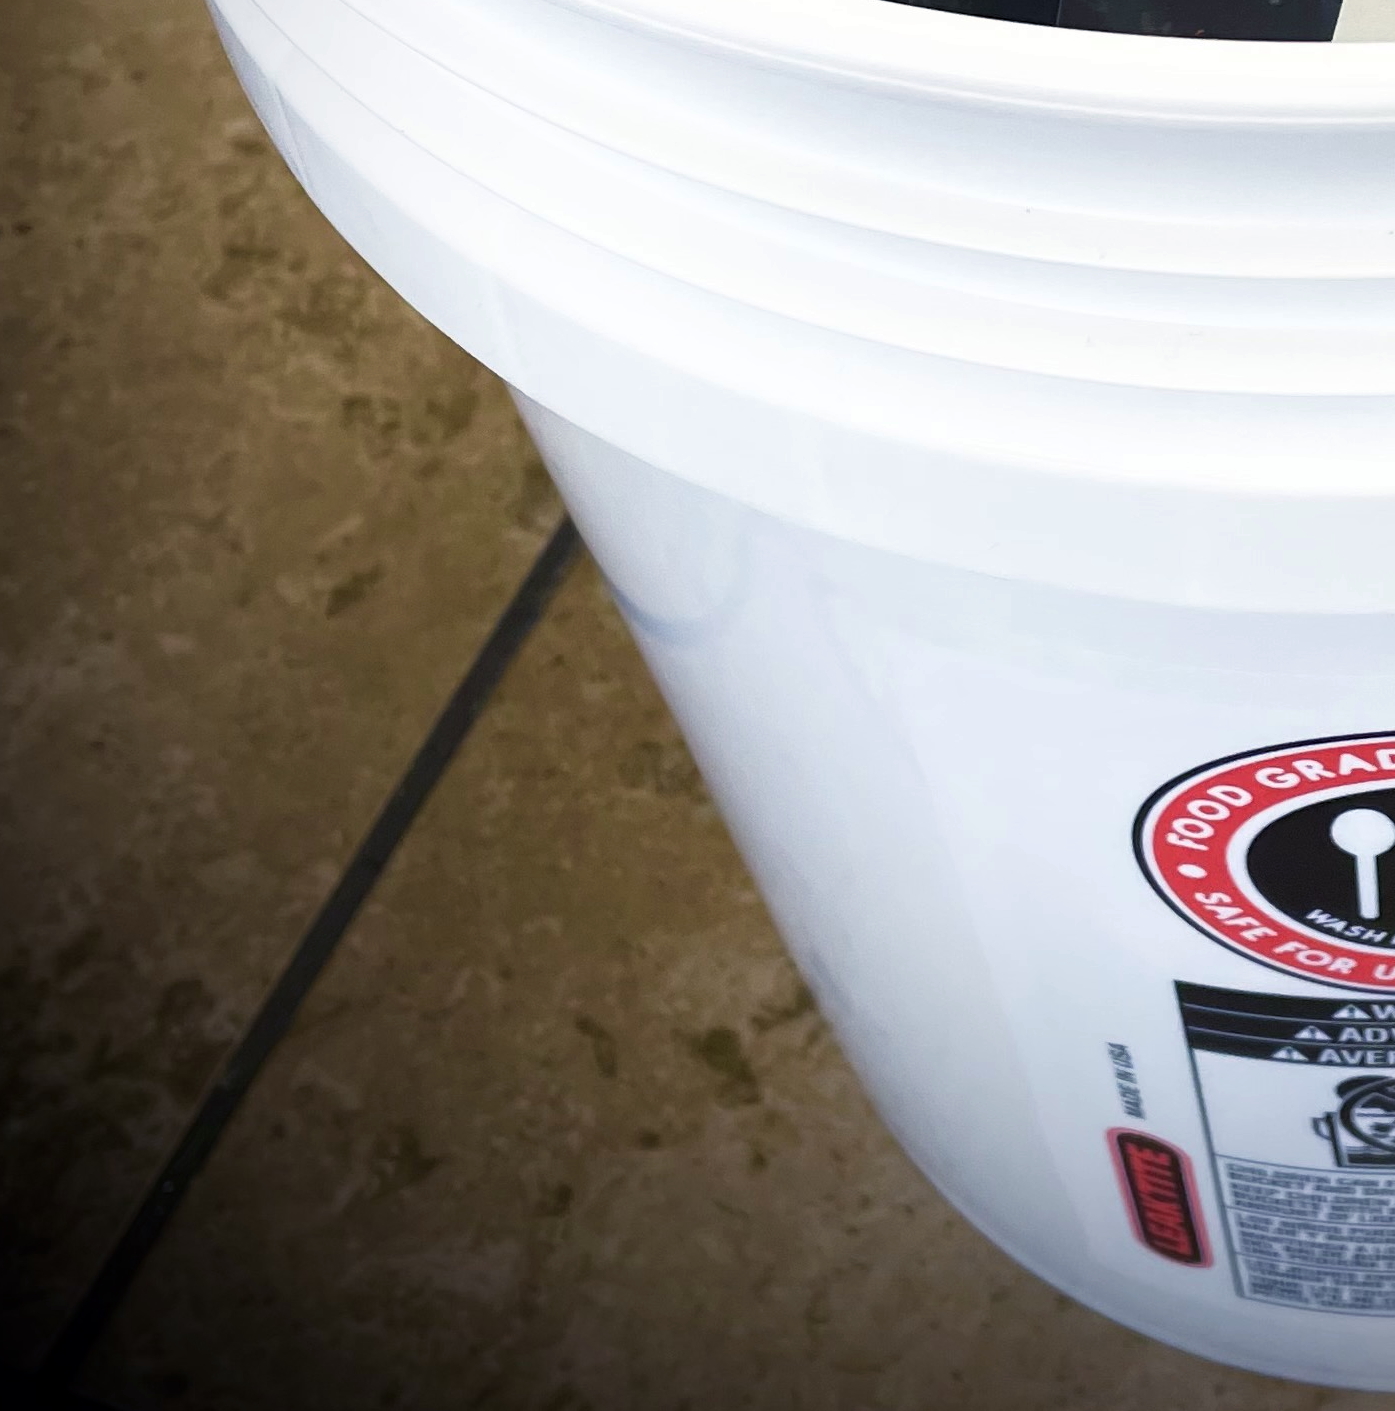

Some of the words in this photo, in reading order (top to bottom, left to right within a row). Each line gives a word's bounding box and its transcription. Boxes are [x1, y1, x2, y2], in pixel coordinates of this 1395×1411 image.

[1166, 785, 1253, 851] FOOD
[1194, 892, 1278, 942] SAFE
[1273, 941, 1357, 974] FOR
[1306, 909, 1387, 943] WASH
[1106, 1042, 1134, 1070] USA
[1114, 1068, 1138, 1085] IN
[1117, 1083, 1146, 1120] MADE
